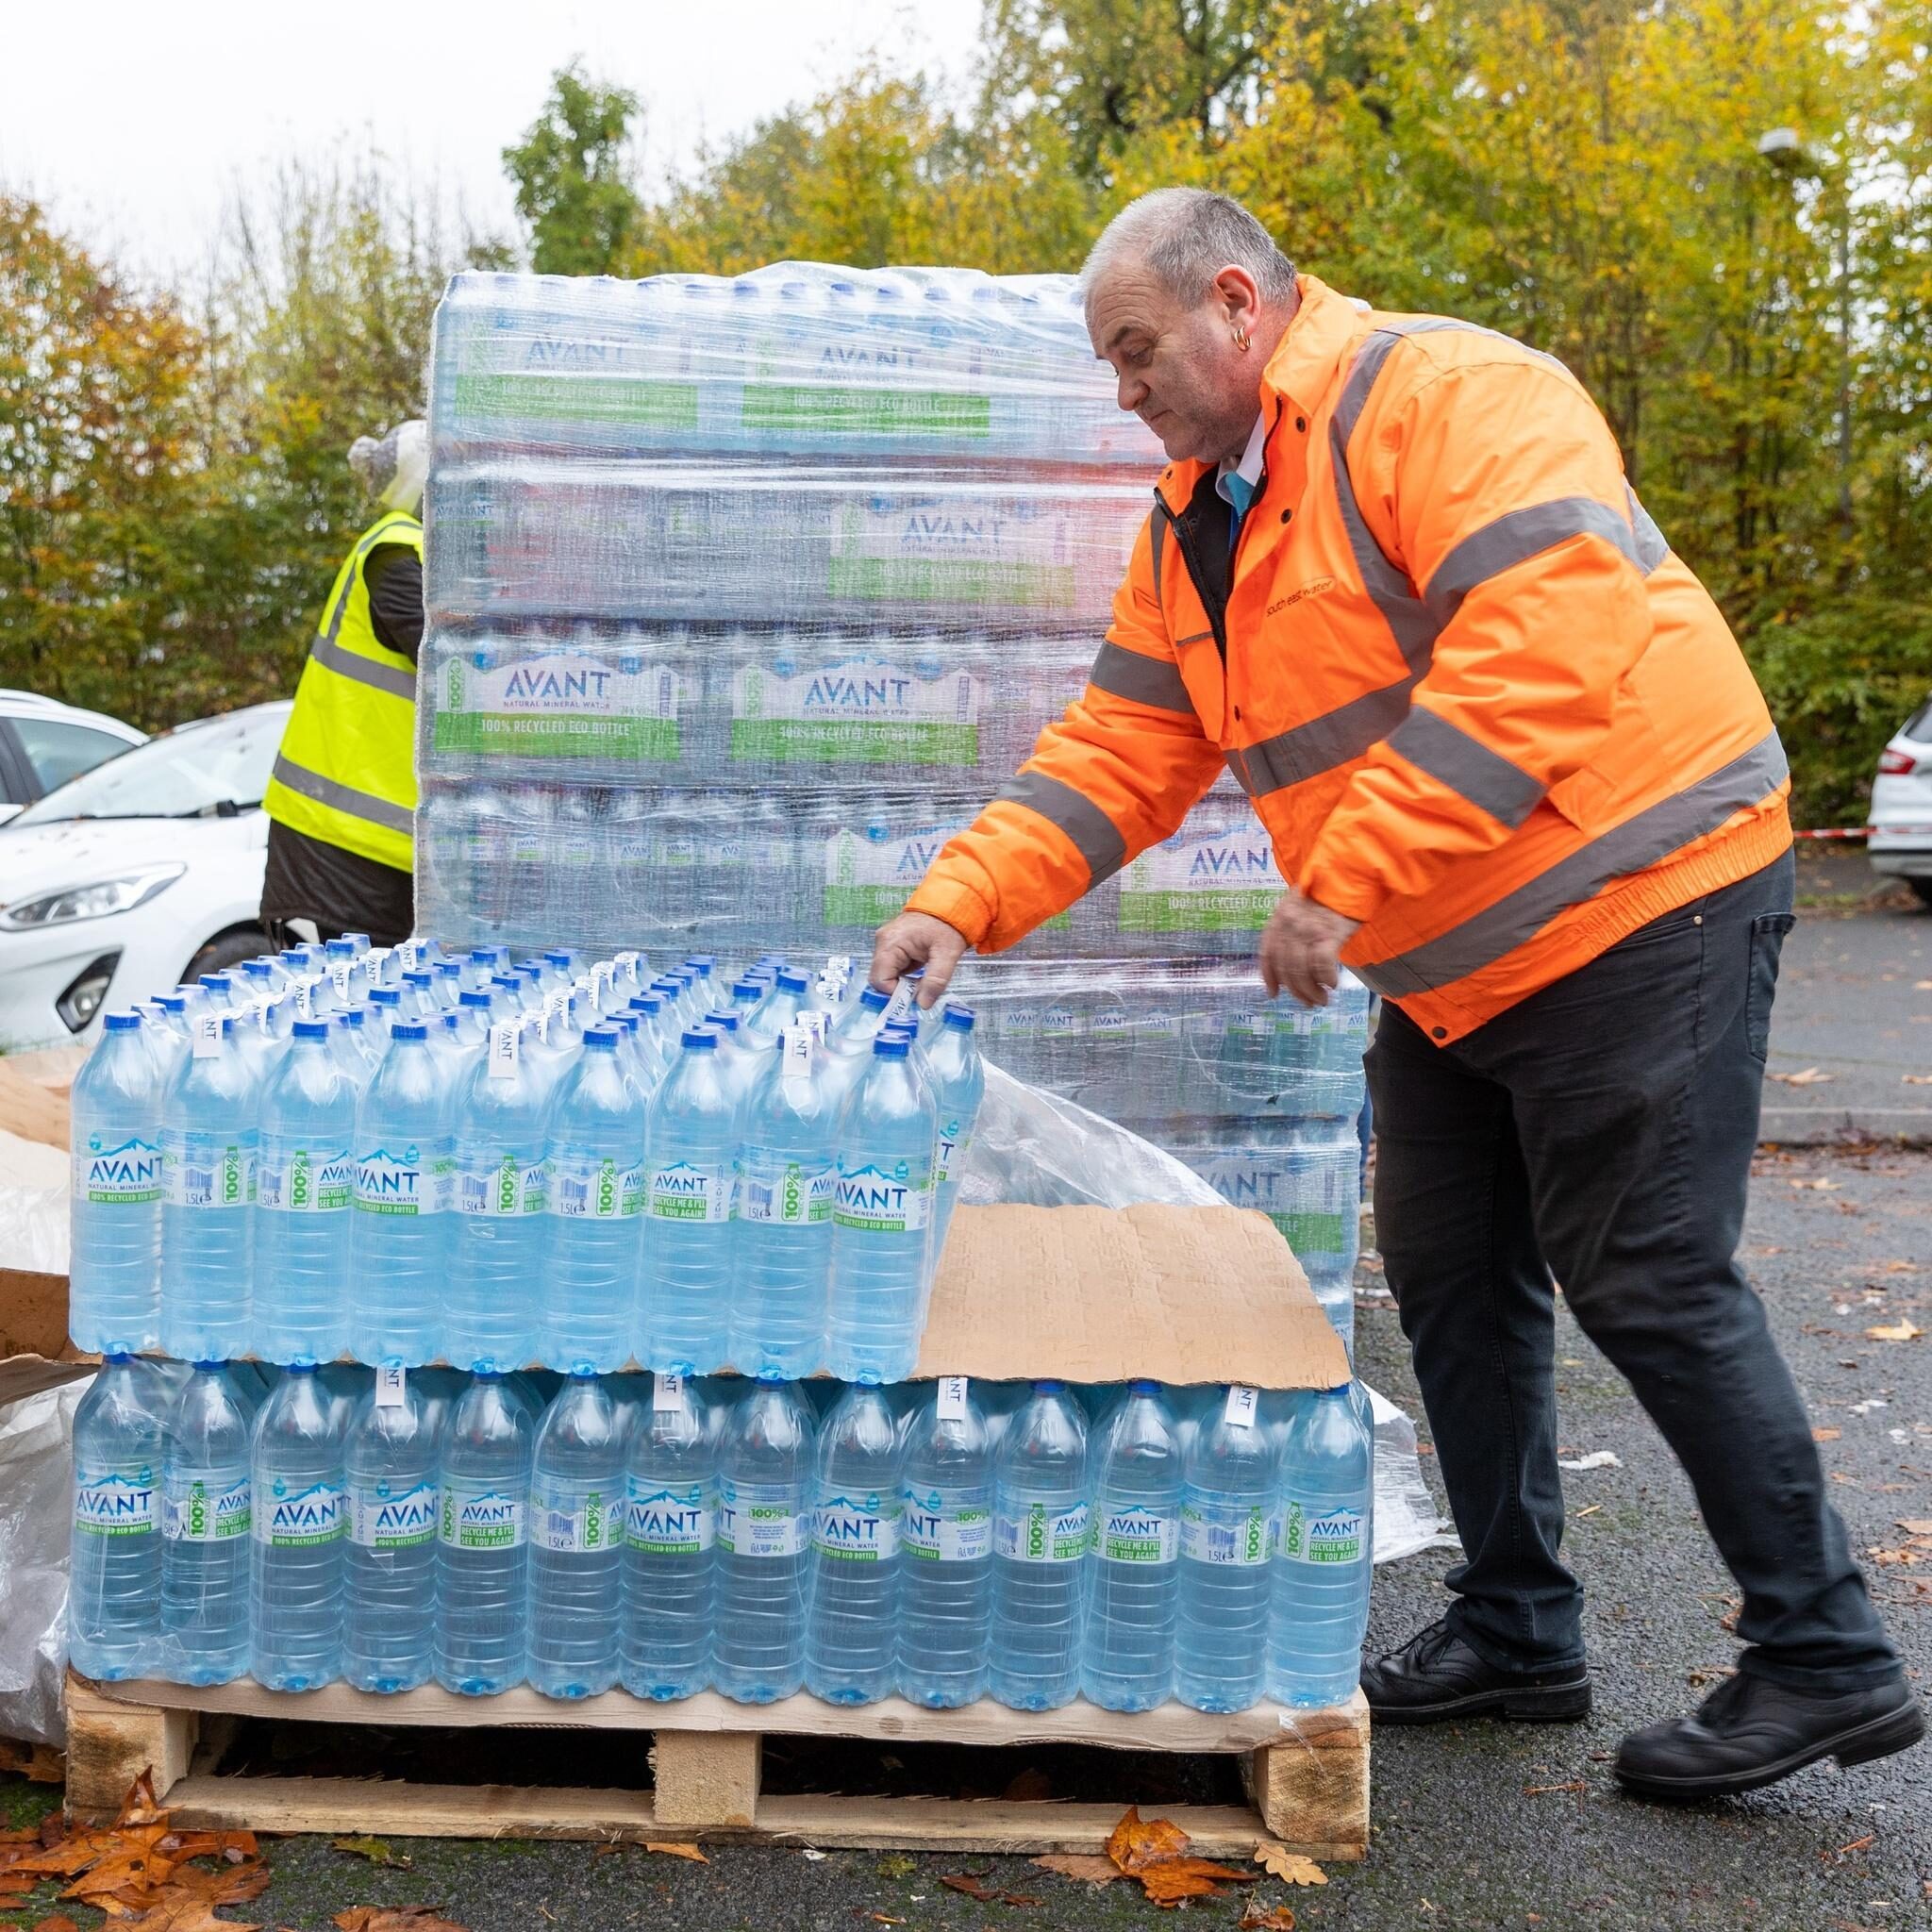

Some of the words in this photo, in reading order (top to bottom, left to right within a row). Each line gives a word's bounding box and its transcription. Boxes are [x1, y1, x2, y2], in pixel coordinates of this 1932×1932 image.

[901, 515, 1007, 544] AVANT
[505, 669, 611, 698] AVANT
[804, 676, 910, 707] AVANT
[482, 719, 511, 732] 100%
[514, 720, 566, 733] RECYCLED
[569, 721, 589, 733] ECO
[591, 722, 631, 735] BOTTLE
[1189, 847, 1268, 876] AVAN
[403, 946, 412, 966] ANT
[333, 965, 344, 988] ANT
[90, 1157, 162, 1183] AVANT
[226, 1155, 238, 1201] 100%
[320, 1165, 353, 1182] AVAN
[292, 1160, 308, 1207] 100%
[356, 1166, 420, 1193] VANT
[500, 1165, 515, 1211] 100%
[655, 1174, 708, 1191] AVANT
[1197, 1172, 1280, 1201] VANT
[600, 1168, 615, 1213] 100%
[785, 1174, 800, 1219] 100%
[835, 1182, 908, 1209] AVANT
[319, 1199, 331, 1208] SEE
[381, 1205, 392, 1213] ECO
[394, 1206, 416, 1215] BOTTLE
[677, 1198, 686, 1208] ME
[687, 1198, 693, 1208] &
[665, 1208, 679, 1217] YOU
[681, 1208, 706, 1218] AGAIN!
[870, 1220, 881, 1228] ECO
[882, 1222, 903, 1230] BOTTLE
[76, 1491, 152, 1516] AVANT
[217, 1491, 251, 1512] AVAN
[132, 1514, 152, 1523] WATER
[191, 1492, 205, 1535] 100%
[375, 1497, 436, 1527] AVAN
[443, 1494, 453, 1539] 100%
[461, 1504, 515, 1521] AVANT
[627, 1507, 702, 1534] AVANT
[750, 1508, 783, 1518] 100%
[216, 1527, 229, 1536] SEE
[461, 1526, 487, 1536] RECYCLE
[488, 1527, 497, 1536] ME
[587, 1502, 601, 1546] 100%
[1056, 1514, 1088, 1533] AVAN
[1108, 1518, 1161, 1535] AVANT
[1311, 1519, 1360, 1536] AVANT
[291, 1536, 321, 1545] RECYCLED
[460, 1536, 473, 1544] SEE
[475, 1537, 490, 1546] YOU
[491, 1536, 514, 1545] AGAIN!
[1029, 1512, 1044, 1557] 100%
[1247, 1515, 1261, 1559] 100%
[1288, 1511, 1300, 1554] 100%
[677, 1544, 698, 1553] BOTTLE
[827, 1540, 855, 1549] MINERAL
[1055, 1548, 1066, 1557] SEE
[1108, 1538, 1132, 1550] RECYCLE
[1132, 1541, 1142, 1551] ME
[1310, 1541, 1337, 1552] RECYCLE
[1337, 1541, 1345, 1551] ME
[841, 1550, 853, 1558] ECO
[854, 1552, 876, 1560] BOTTLE
[918, 1548, 938, 1559] BOTTLE
[1107, 1548, 1118, 1557] SEE
[1120, 1550, 1133, 1560] YOU
[1135, 1550, 1159, 1561] AGAIN!
[1208, 1550, 1222, 1562] 1.5L
[1309, 1552, 1323, 1561] SEE
[1324, 1552, 1338, 1561] YOU
